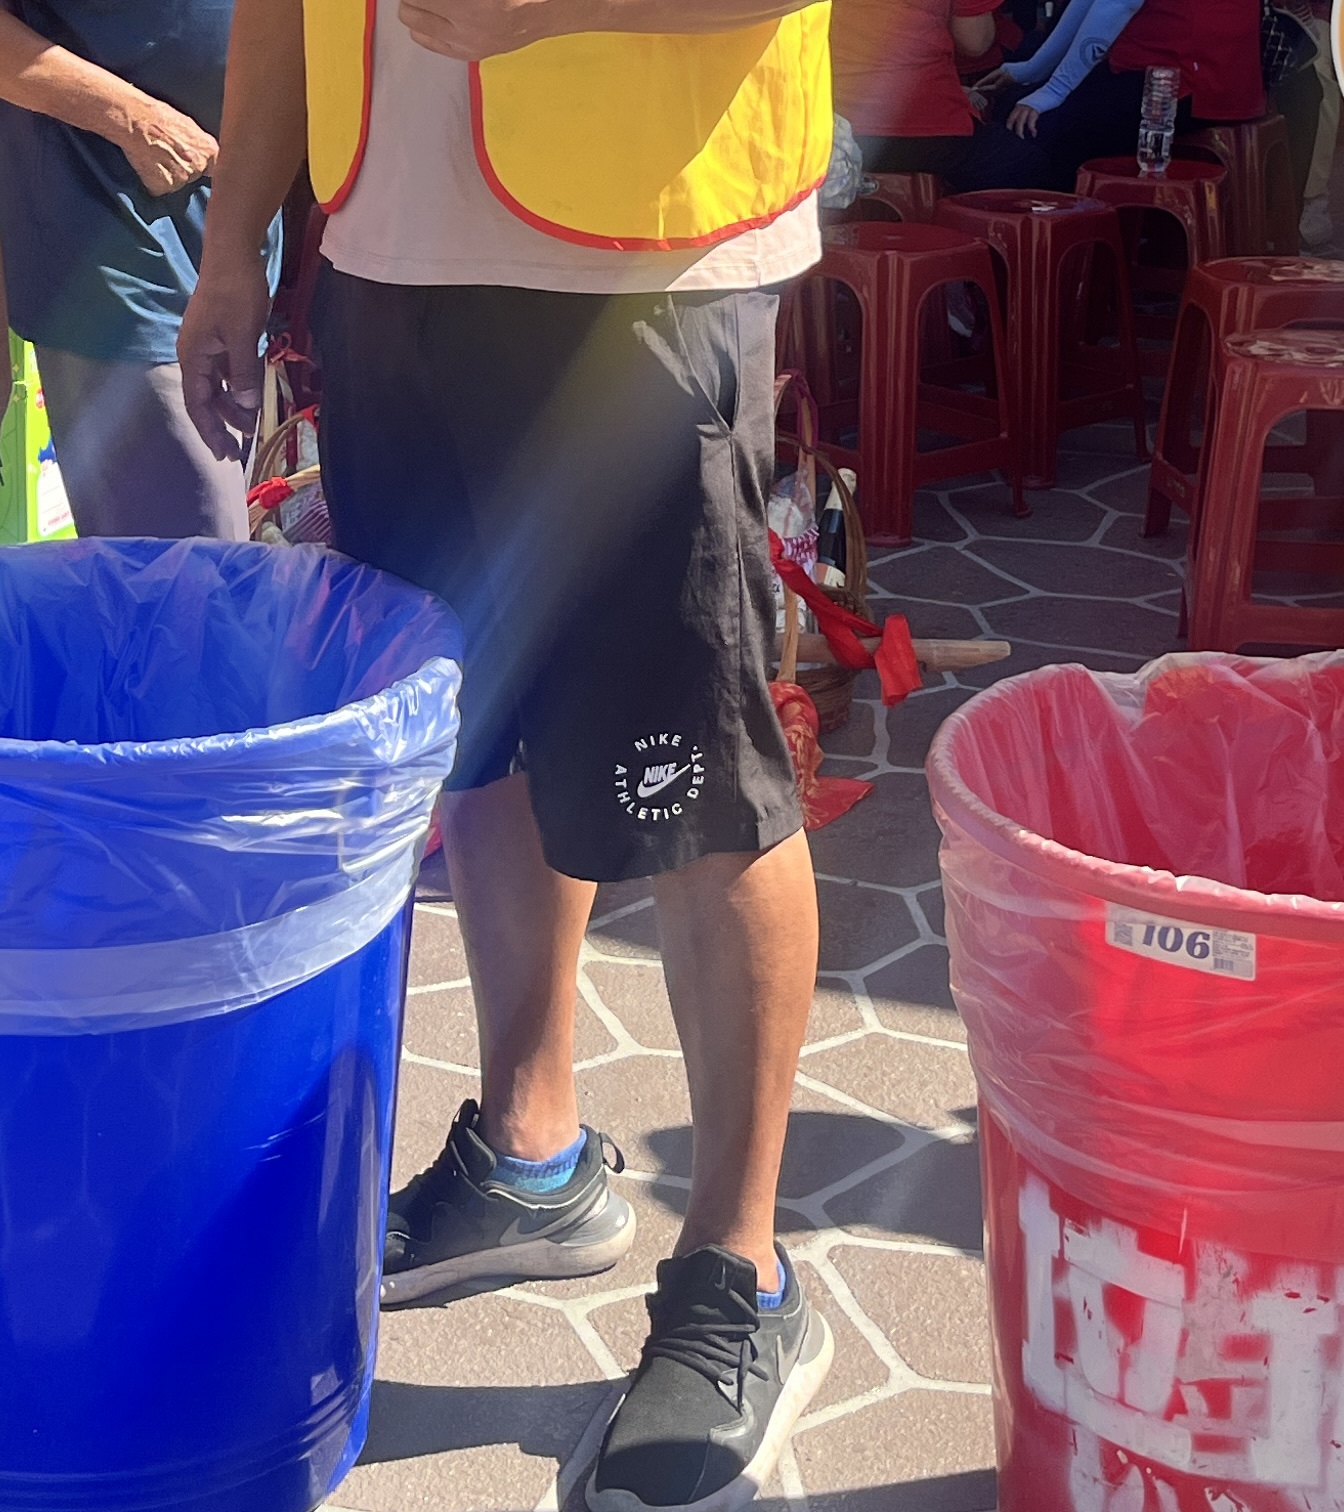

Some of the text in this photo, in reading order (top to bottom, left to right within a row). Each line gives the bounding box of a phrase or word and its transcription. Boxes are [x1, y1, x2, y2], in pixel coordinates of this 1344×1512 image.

[634, 733, 682, 752] NIKE
[643, 762, 677, 785] NIKE
[615, 764, 683, 821] ATHLETIC
[1142, 924, 1211, 959] 106
